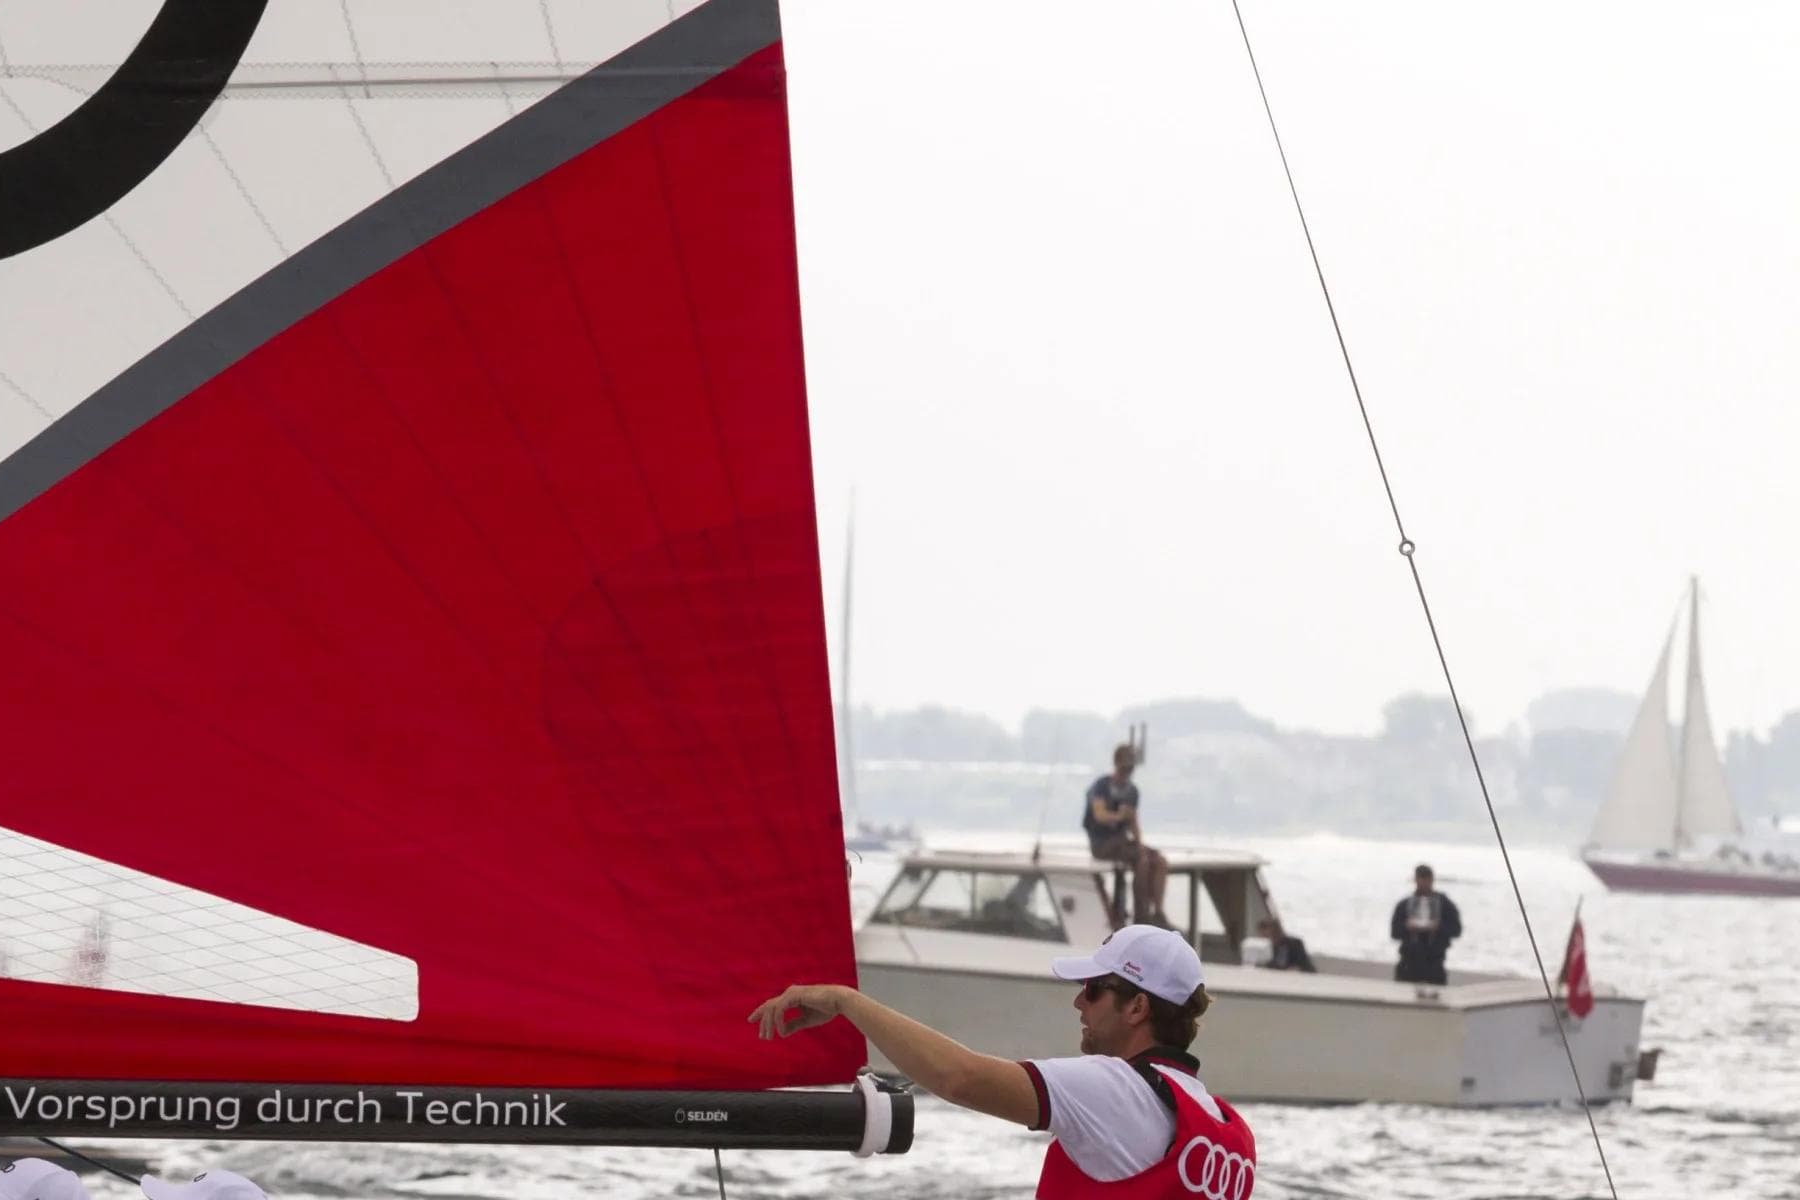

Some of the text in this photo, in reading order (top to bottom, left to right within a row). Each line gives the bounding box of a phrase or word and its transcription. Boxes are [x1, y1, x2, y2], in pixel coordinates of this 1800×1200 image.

[4, 1087, 240, 1130] Vorsprung
[256, 1089, 382, 1124] durch
[395, 1090, 567, 1127] Technik
